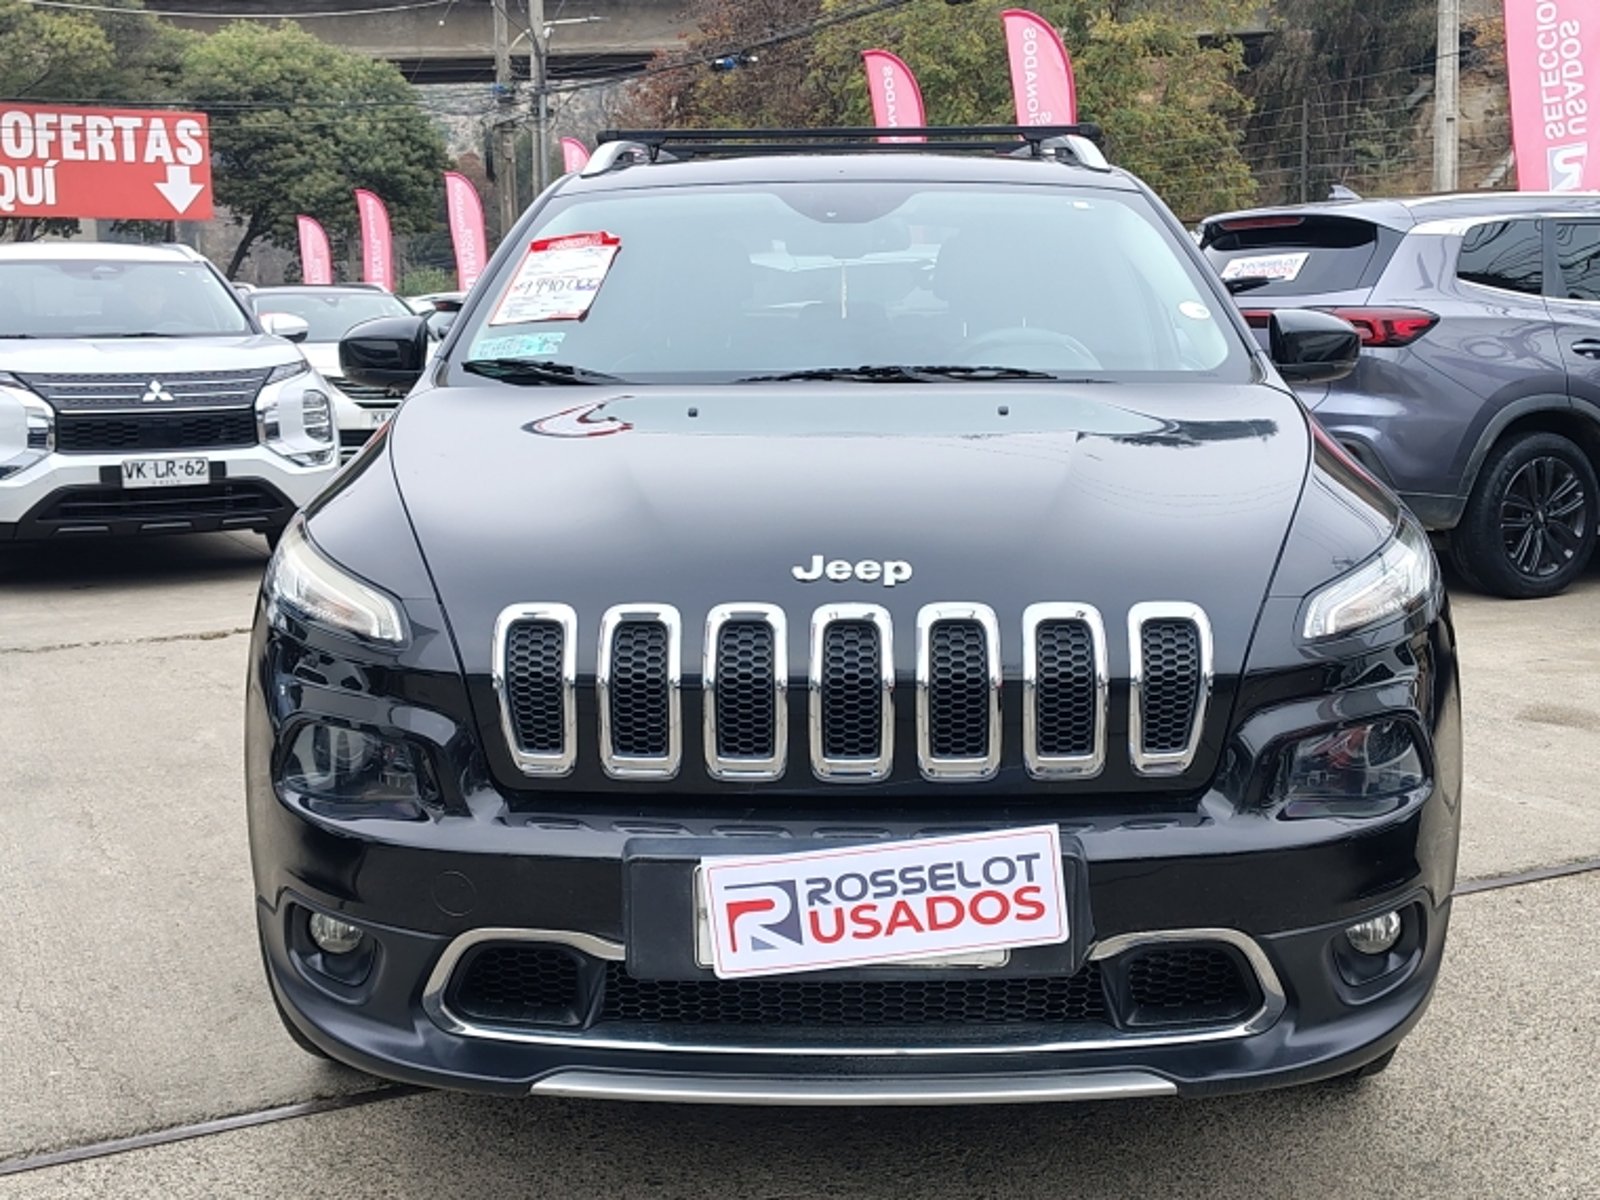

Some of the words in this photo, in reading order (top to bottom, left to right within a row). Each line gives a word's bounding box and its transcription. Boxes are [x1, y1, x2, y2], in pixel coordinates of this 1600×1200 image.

[1, 110, 204, 165] OFERTAS
[791, 554, 913, 587] Jeep
[805, 853, 1041, 907] ROSSELOT
[807, 886, 1046, 944] USADOS
